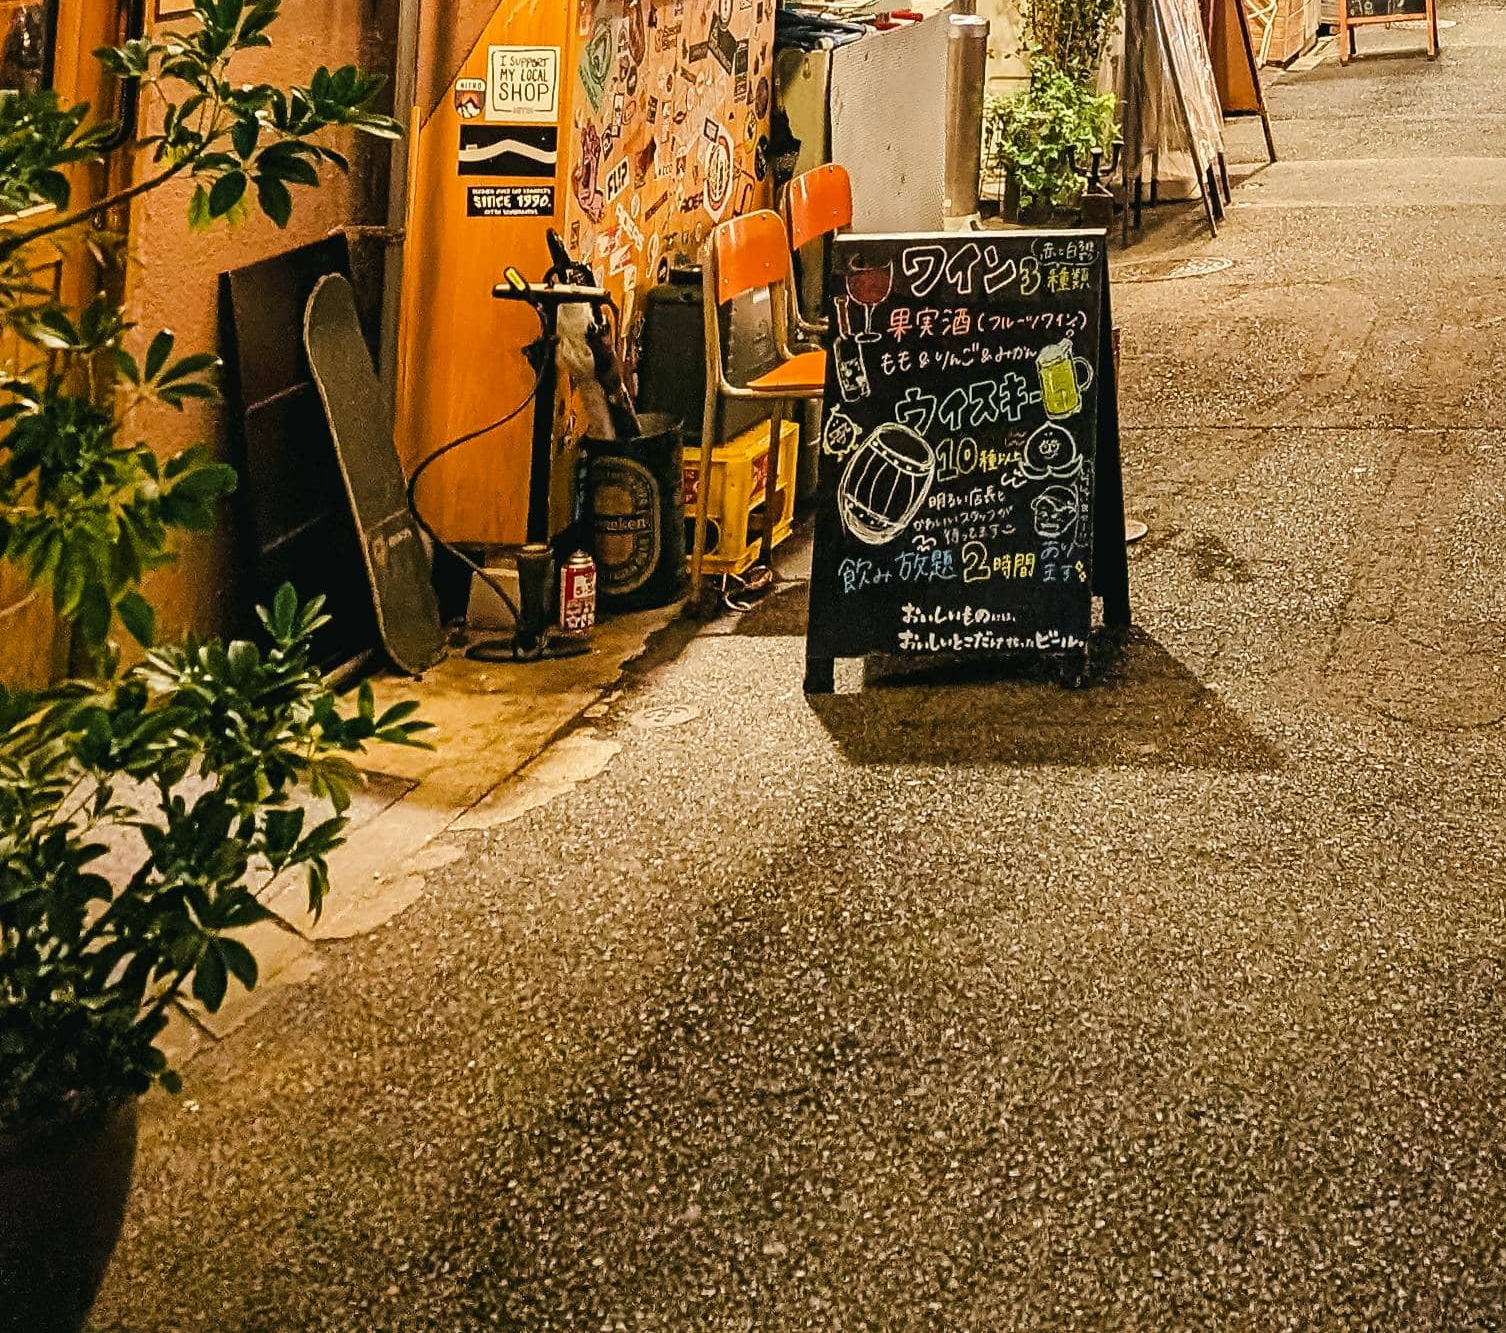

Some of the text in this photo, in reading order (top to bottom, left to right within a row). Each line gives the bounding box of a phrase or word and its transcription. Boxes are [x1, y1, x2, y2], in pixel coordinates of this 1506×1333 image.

[500, 55, 550, 68] I SUPPORT
[500, 68, 548, 82] MY LOCAL
[499, 82, 549, 102] SHOP
[473, 194, 512, 208] SINCE
